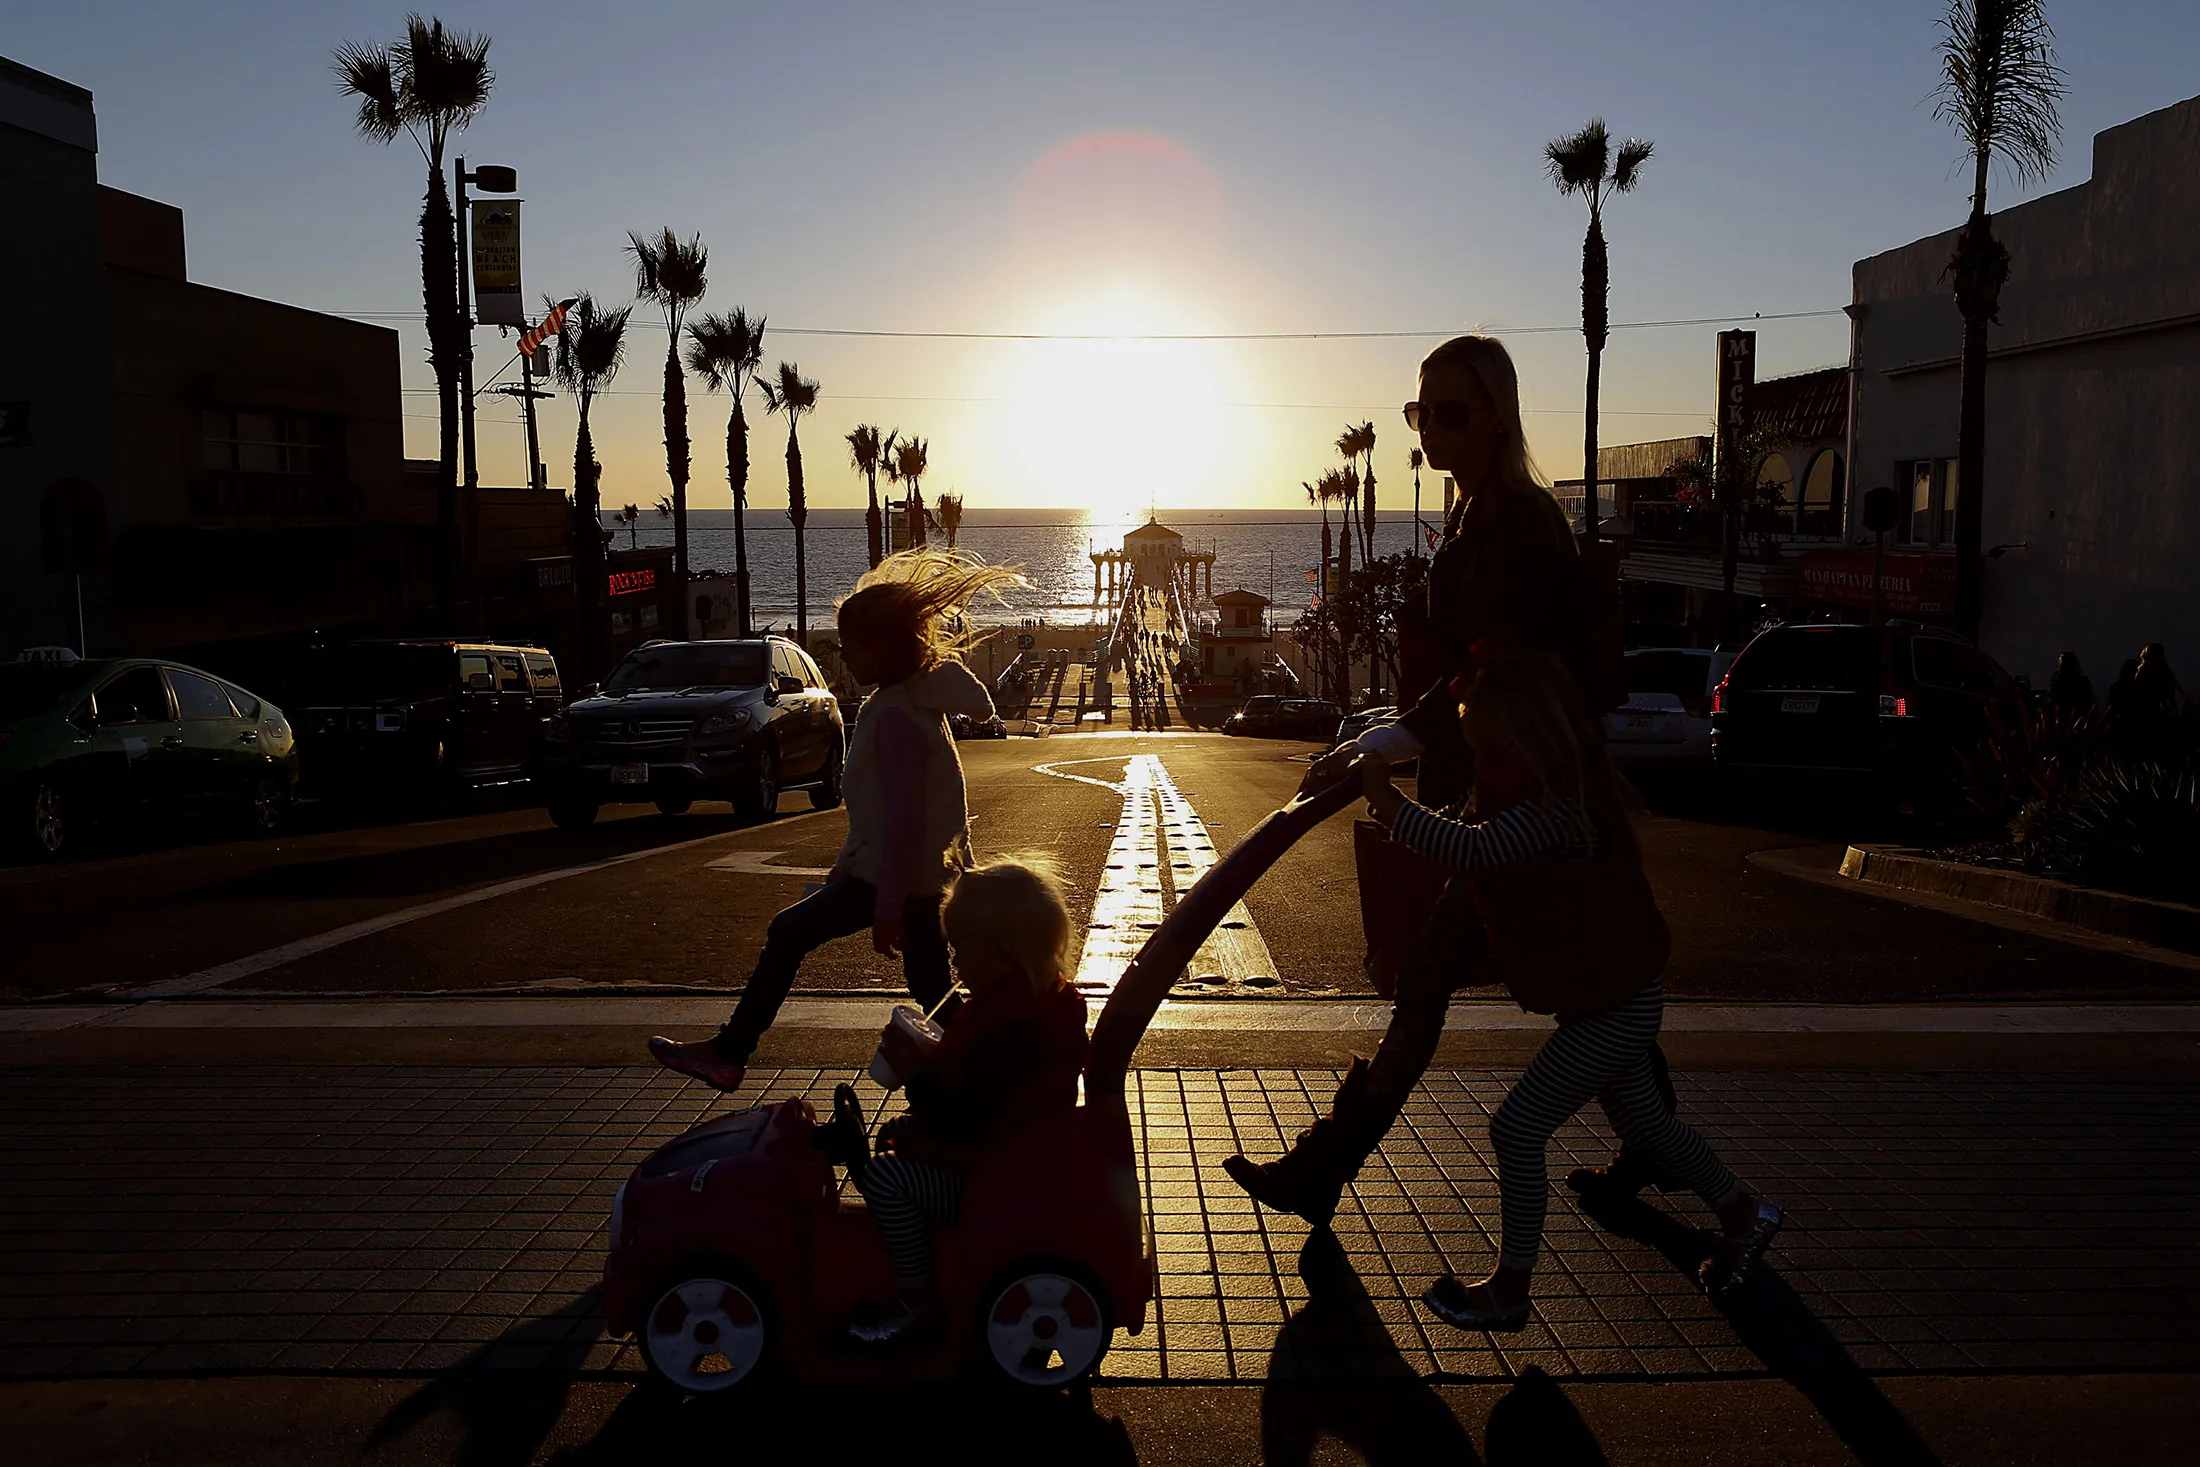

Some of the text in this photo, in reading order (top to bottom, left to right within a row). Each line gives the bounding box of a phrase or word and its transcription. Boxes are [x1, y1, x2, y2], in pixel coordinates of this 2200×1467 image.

[476, 254, 516, 264] BEACH
[1804, 569, 1859, 587] MANHATTAN
[1862, 573, 1911, 592] PIZERIA
[24, 649, 61, 663] TAXI
